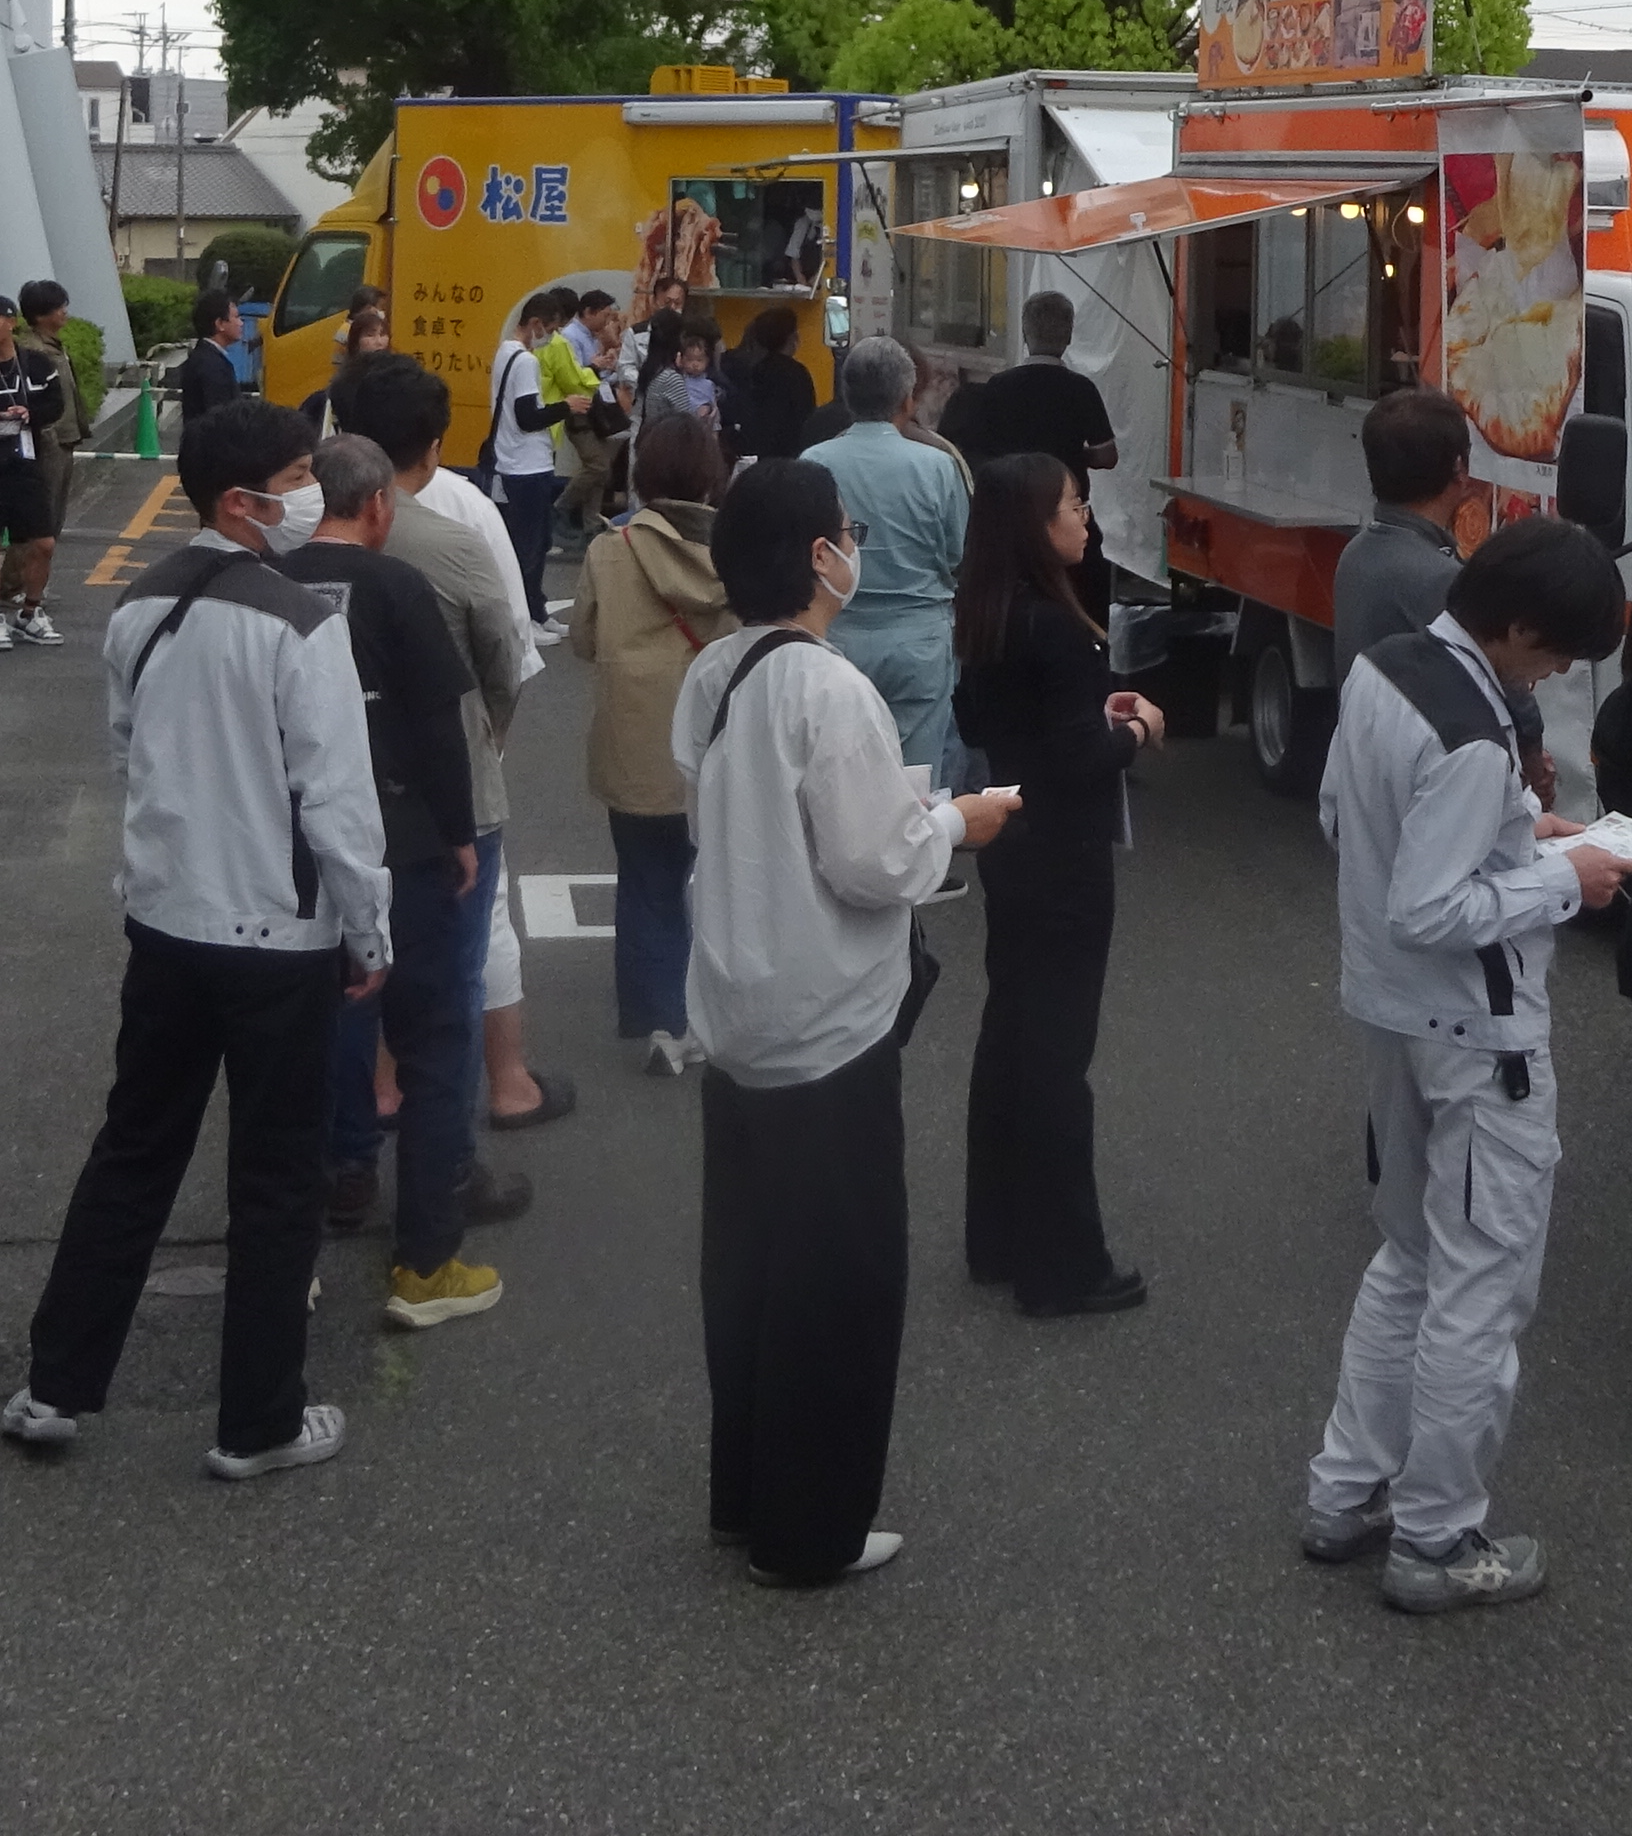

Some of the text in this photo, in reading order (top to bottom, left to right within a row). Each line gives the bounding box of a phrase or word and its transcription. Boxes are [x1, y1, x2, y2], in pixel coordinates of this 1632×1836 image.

[479, 165, 569, 223] 松屋
[413, 282, 484, 304] みんなの
[412, 315, 465, 339] 食卓で
